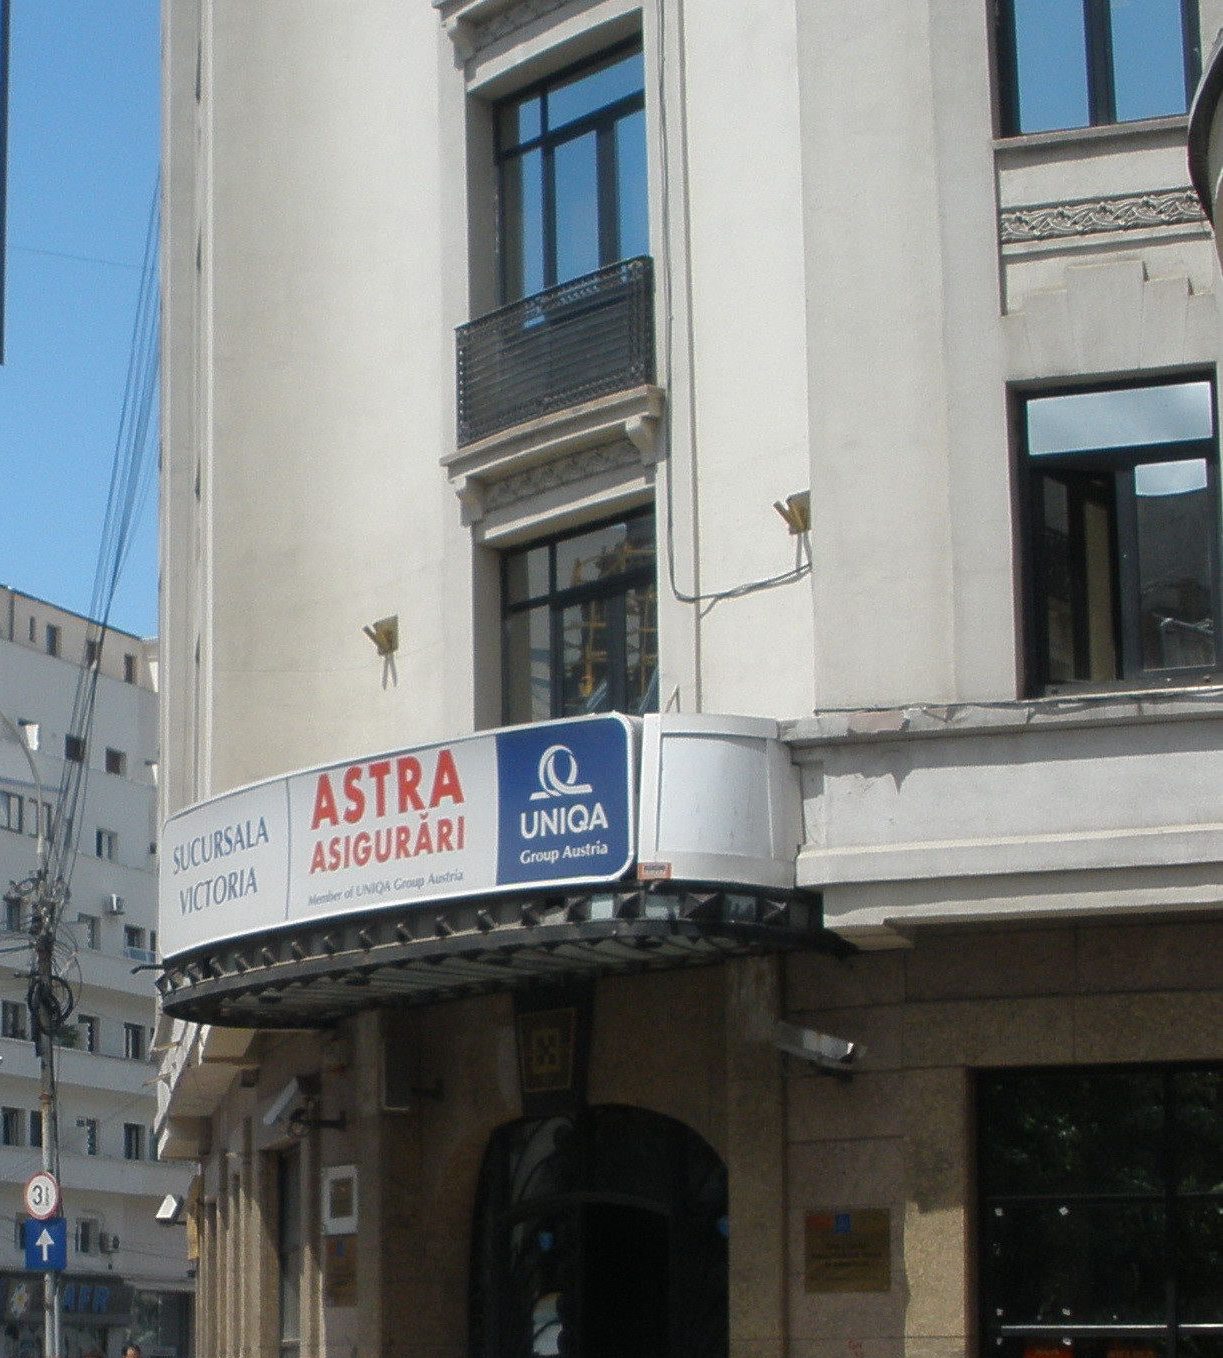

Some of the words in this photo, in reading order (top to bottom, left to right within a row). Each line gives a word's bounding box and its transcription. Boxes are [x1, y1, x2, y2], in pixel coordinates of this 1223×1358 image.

[309, 748, 465, 831] ASTRA
[172, 815, 270, 876] SUCURSALA
[308, 812, 465, 875] ASIGURĂRI
[519, 801, 609, 840] UNIQA
[519, 849, 560, 865] Group
[562, 840, 609, 859] Austria
[179, 865, 258, 917] VICTORIA
[356, 880, 391, 897] UNIQA
[393, 877, 425, 891] Group
[427, 868, 464, 885] Austria
